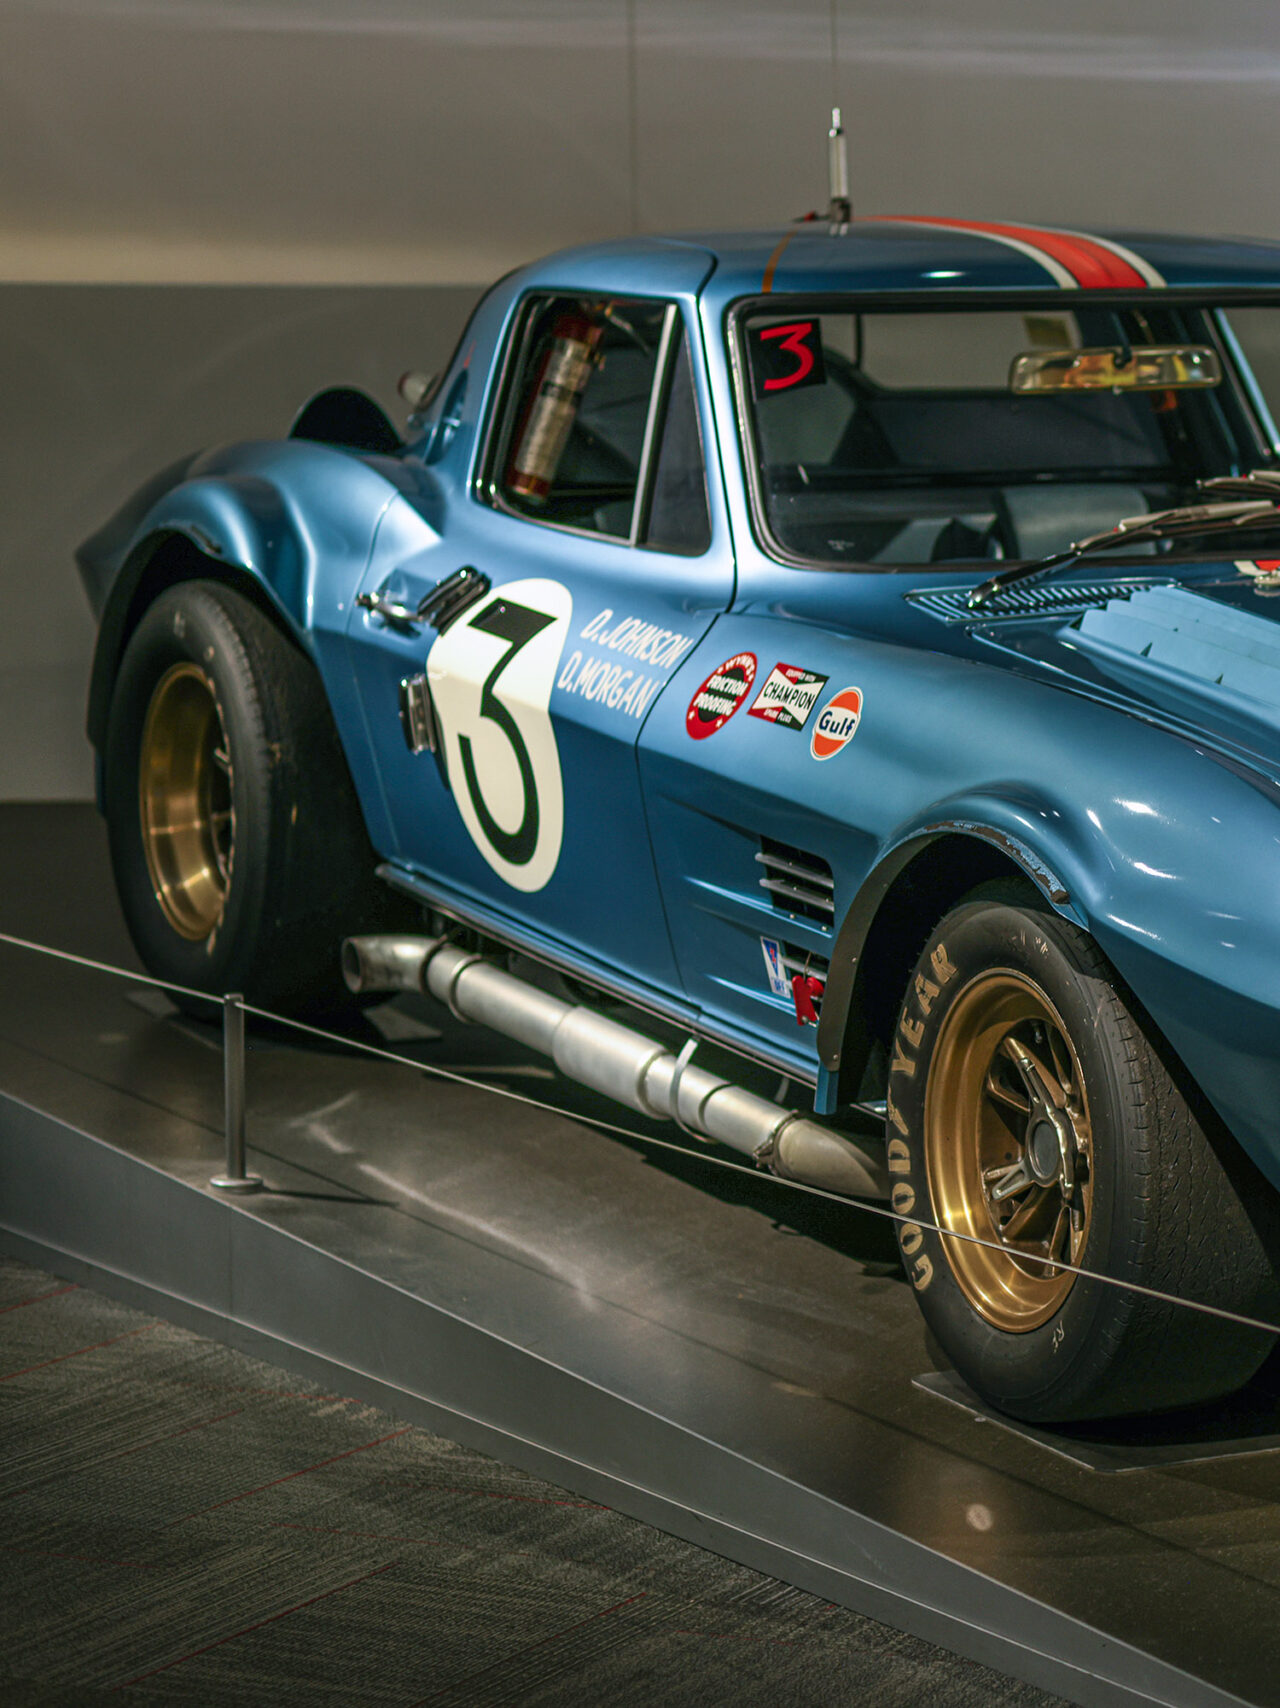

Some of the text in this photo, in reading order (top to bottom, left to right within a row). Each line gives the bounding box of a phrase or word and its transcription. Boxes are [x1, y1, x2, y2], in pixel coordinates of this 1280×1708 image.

[760, 323, 814, 391] 3
[706, 674, 749, 697] FRICTION
[763, 681, 815, 710] CHAMPION
[693, 692, 737, 716] PROOFING
[458, 597, 558, 866] 3
[819, 711, 855, 736] Gulf
